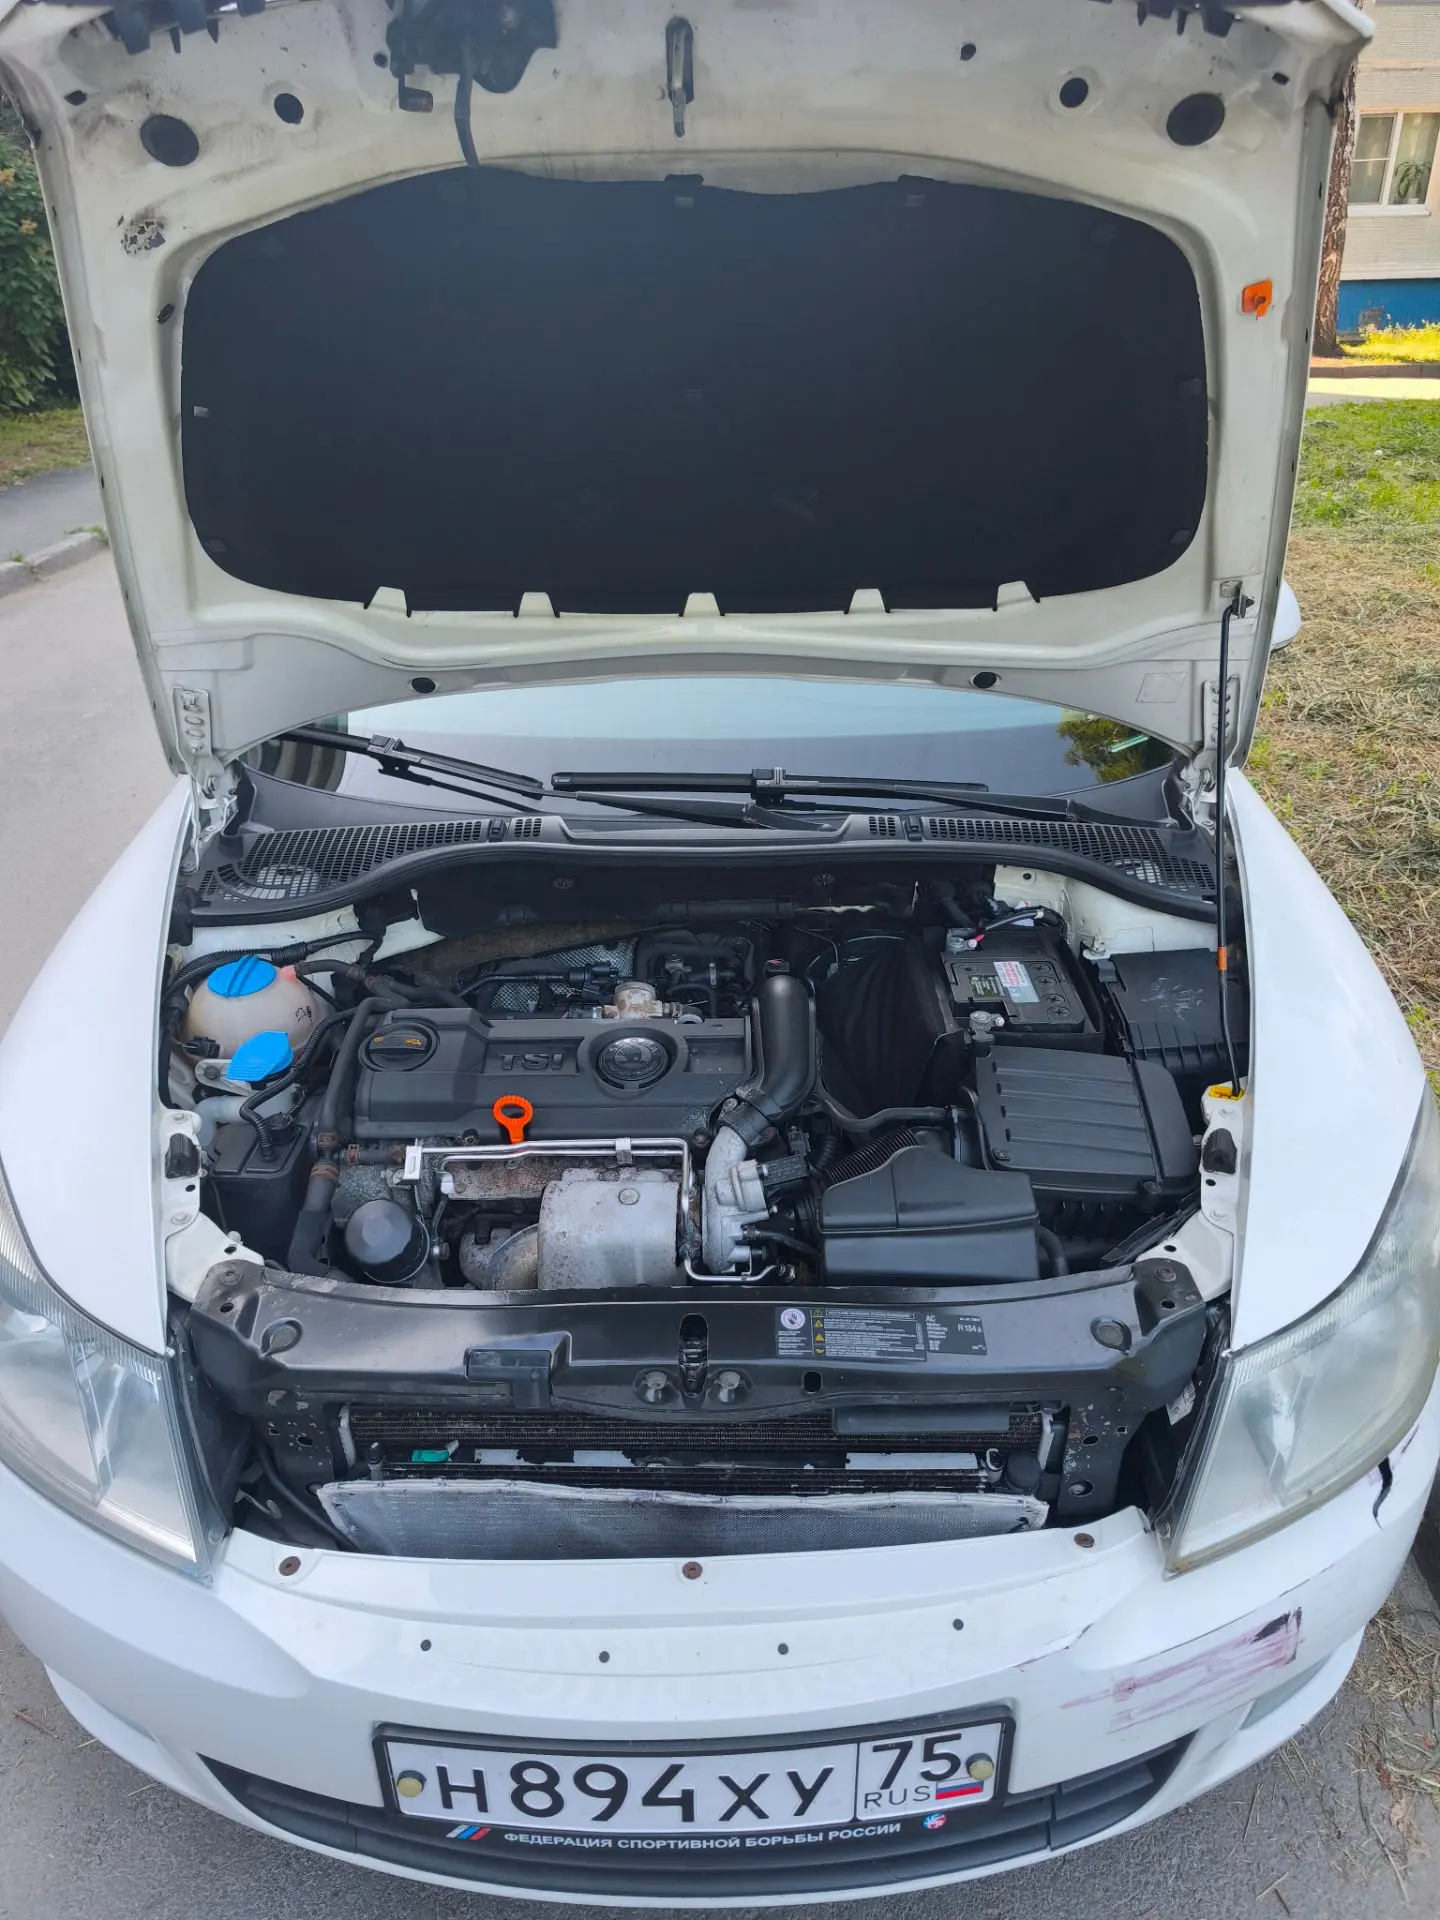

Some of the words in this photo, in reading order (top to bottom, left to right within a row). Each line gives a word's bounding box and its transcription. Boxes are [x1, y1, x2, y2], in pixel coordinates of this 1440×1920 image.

[501, 1053, 563, 1070] TSI
[872, 1732, 962, 1790] 75
[864, 1785, 931, 1809] RUS
[503, 1832, 613, 1849] ФЕДЕРАЦИЯ
[617, 1836, 740, 1849] СПОРТИВНОЙ
[745, 1832, 823, 1847] БОРЬБЫ
[828, 1823, 901, 1841] РОССИИ
